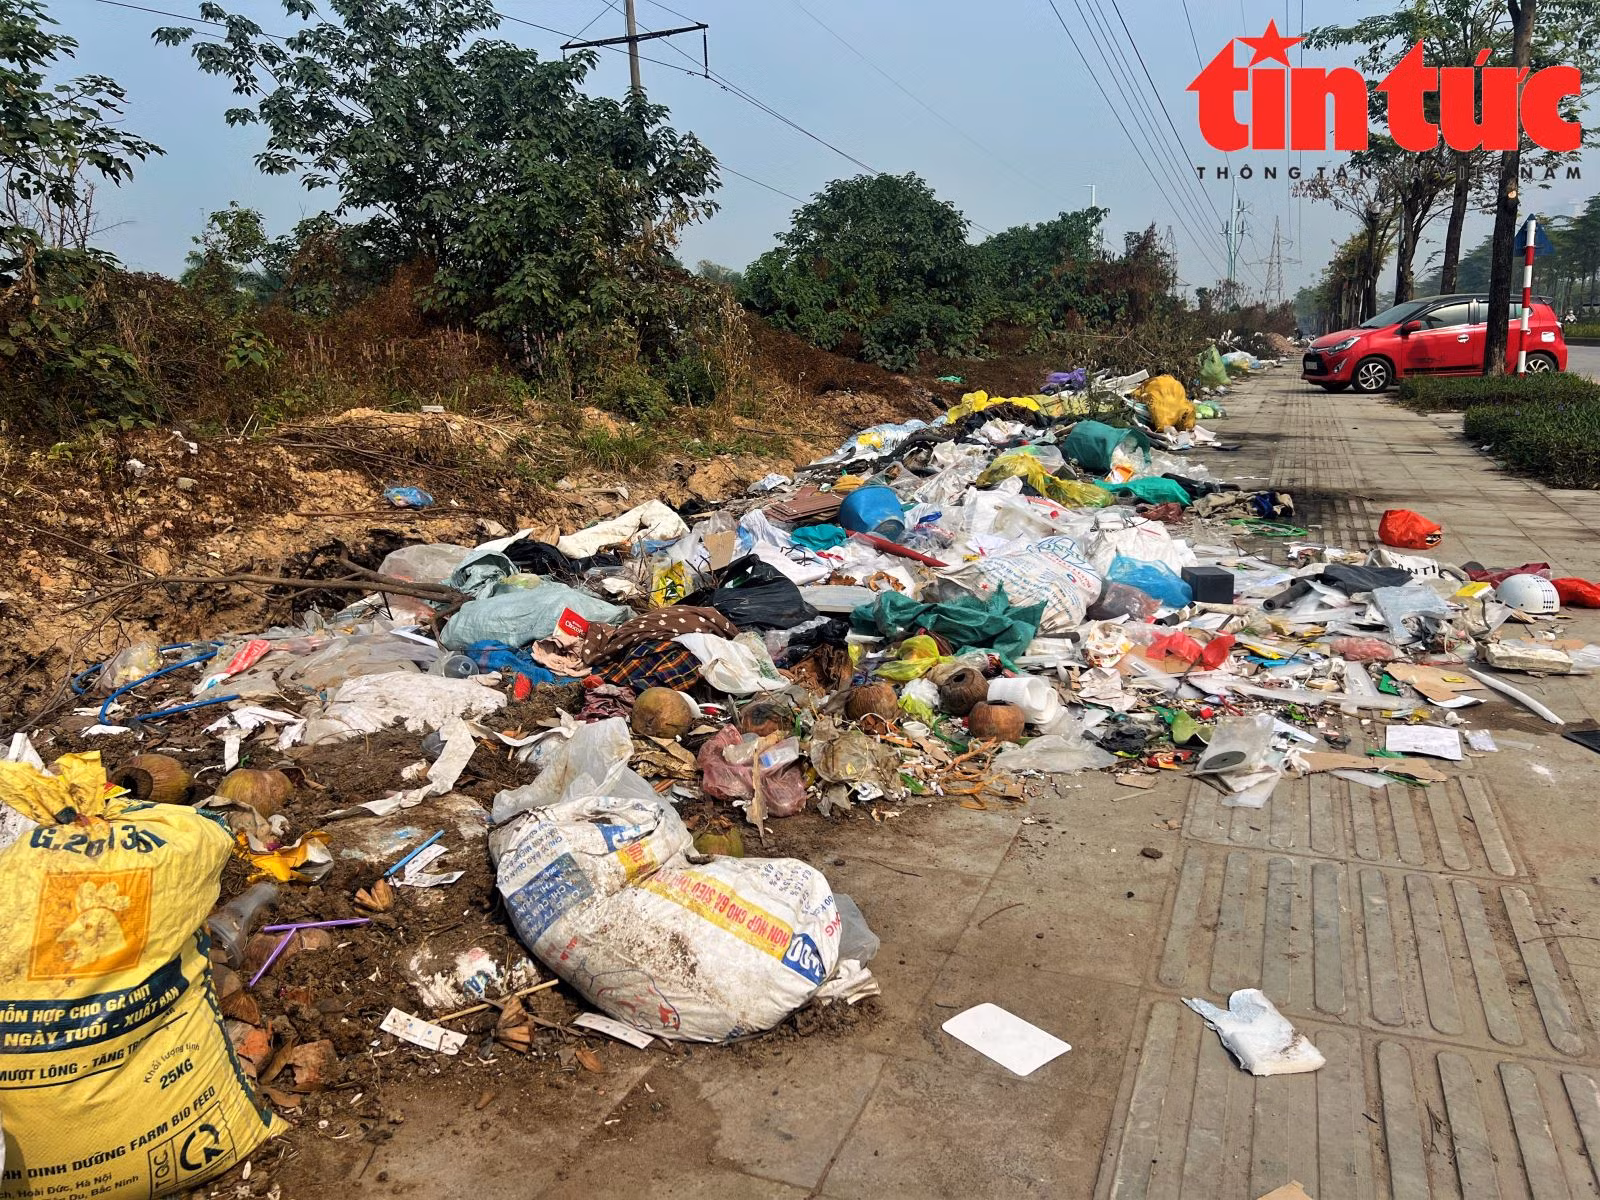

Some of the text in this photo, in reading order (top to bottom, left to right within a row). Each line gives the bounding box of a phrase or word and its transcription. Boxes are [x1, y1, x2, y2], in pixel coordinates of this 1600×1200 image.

[32, 1008, 66, 1026] HỢP
[70, 1002, 101, 1019] CHO
[4, 1029, 59, 1046] NGÀY
[40, 1063, 78, 1080] LÔNG
[160, 1058, 194, 1090] 25KG
[27, 1164, 67, 1179] DINH
[130, 1121, 169, 1152] FARM
[171, 1106, 191, 1127] BIO
[193, 1085, 216, 1111] FEED
[115, 1175, 140, 1189] Ninh
